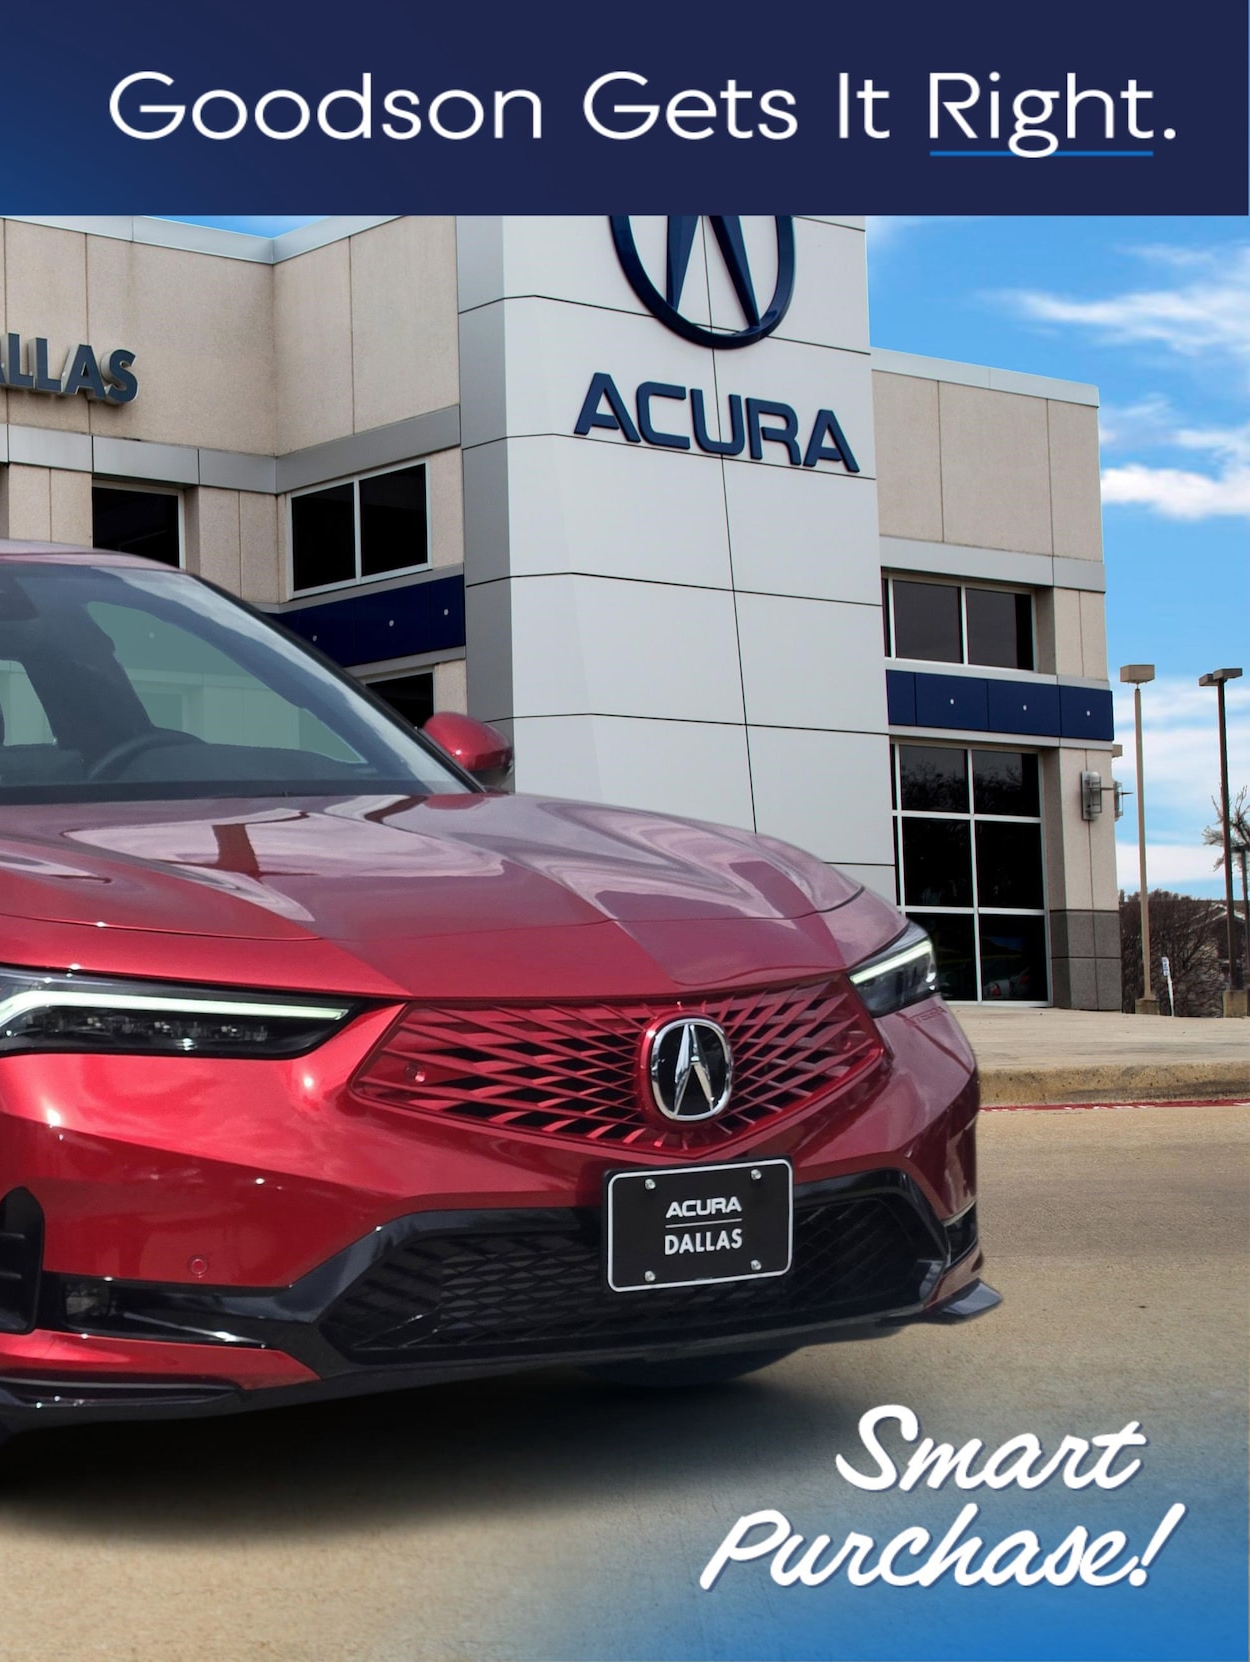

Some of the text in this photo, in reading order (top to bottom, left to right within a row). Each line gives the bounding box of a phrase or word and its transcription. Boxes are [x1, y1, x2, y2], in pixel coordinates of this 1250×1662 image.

[573, 372, 860, 473] ACURA
[665, 1196, 742, 1219] ACURA
[664, 1228, 743, 1256] DALLAS
